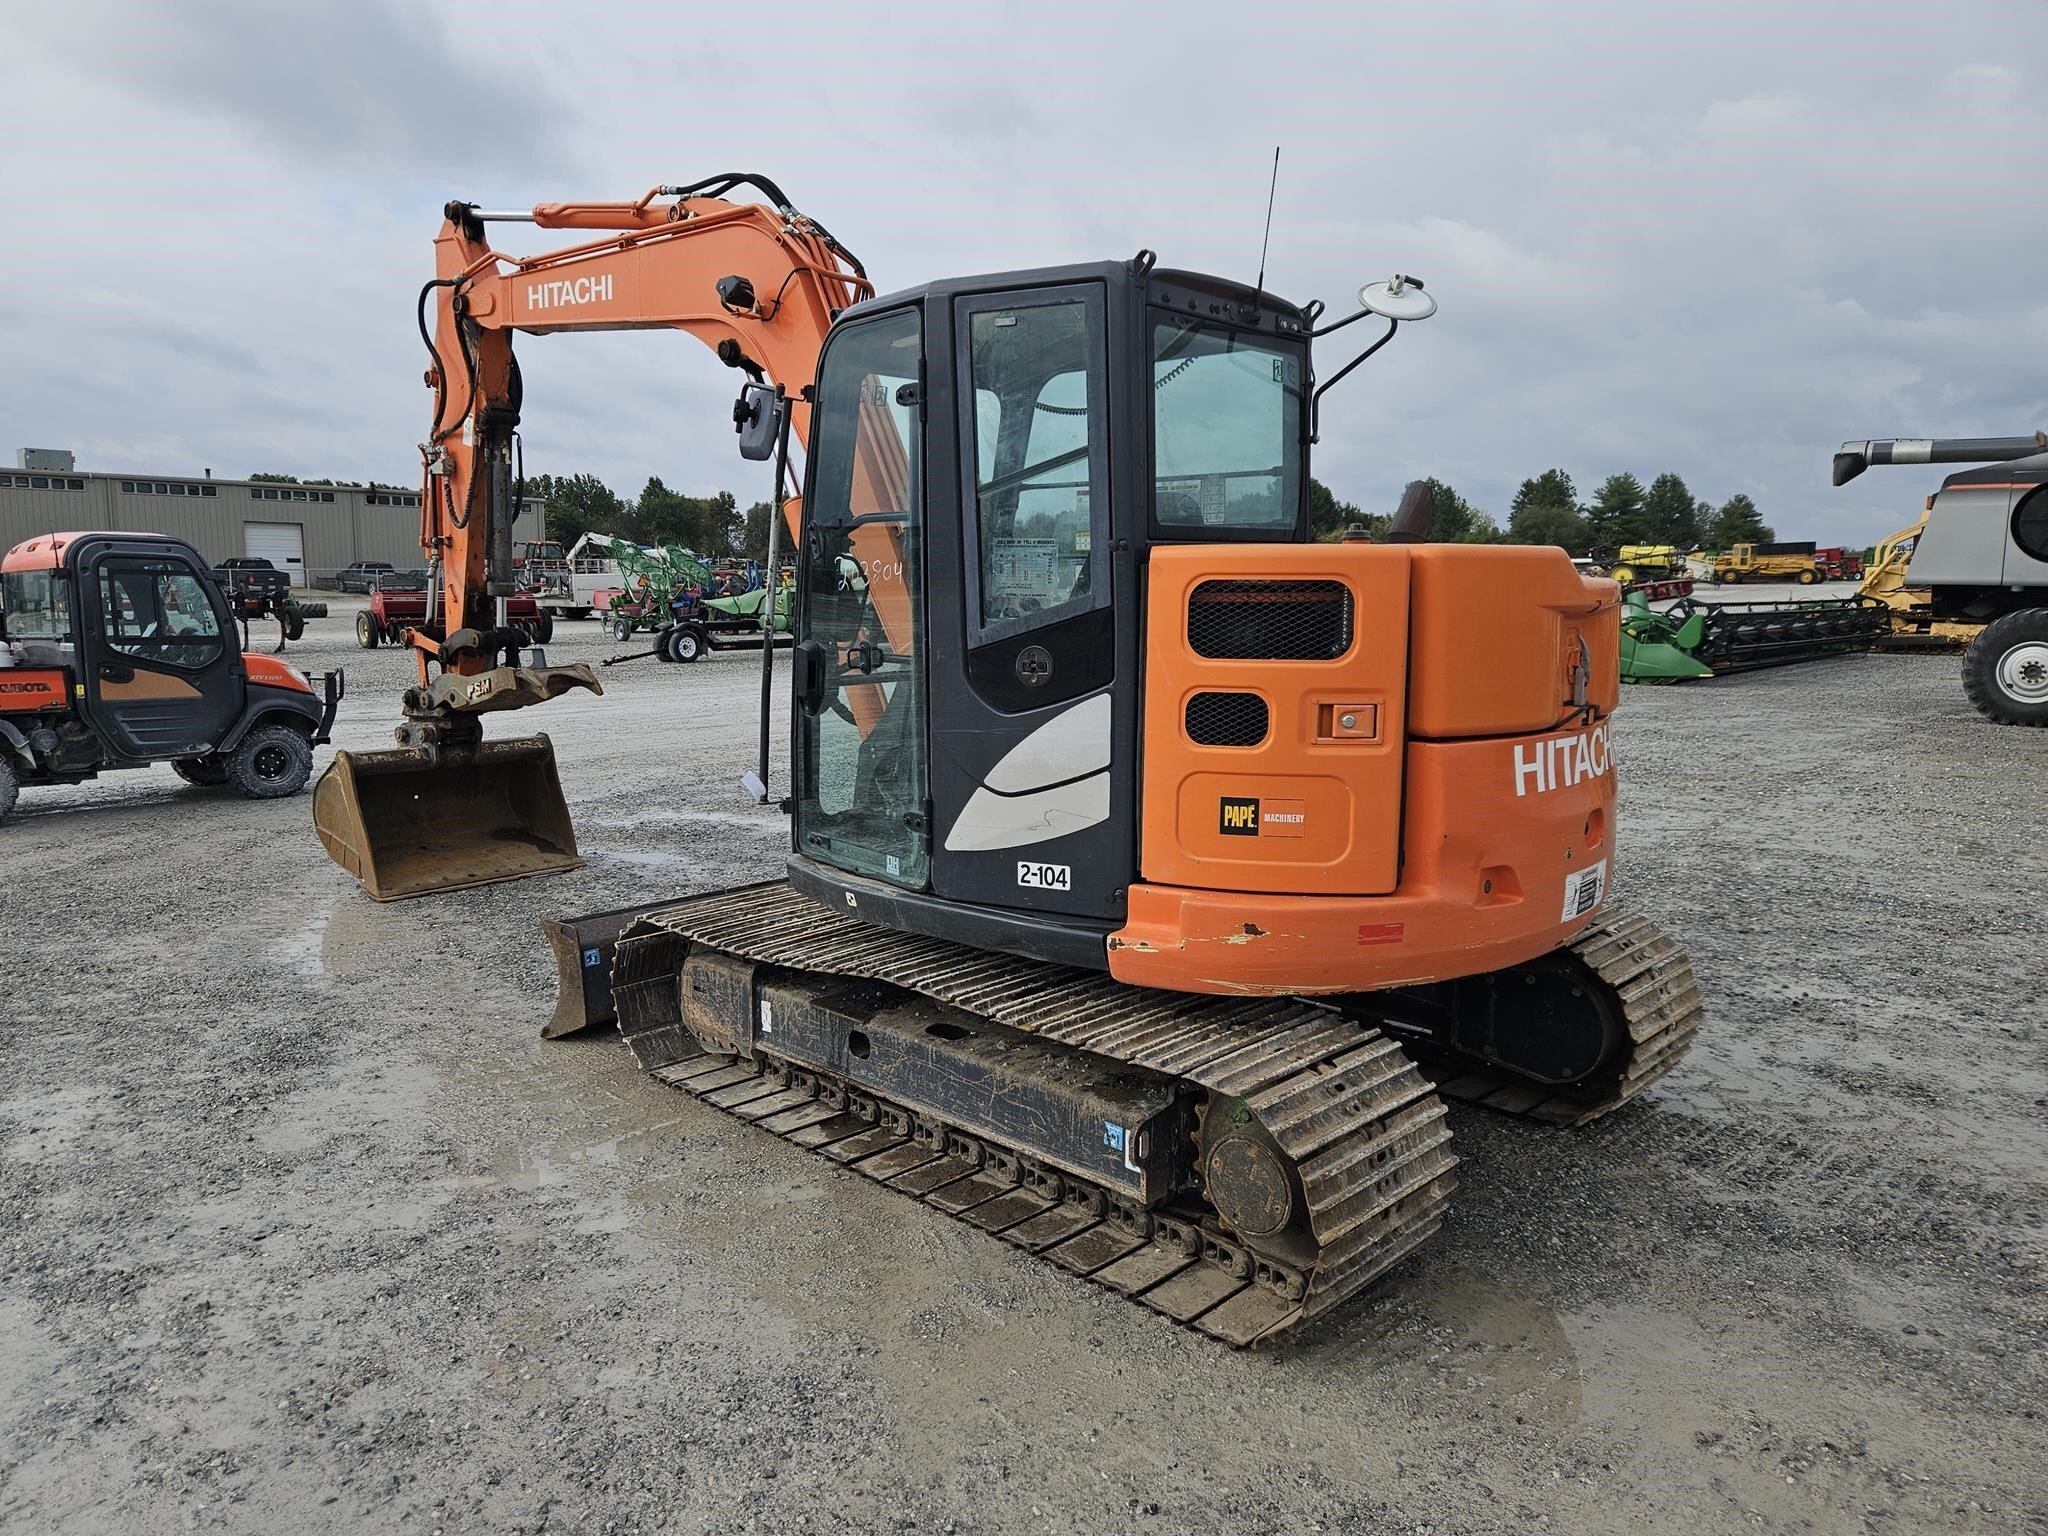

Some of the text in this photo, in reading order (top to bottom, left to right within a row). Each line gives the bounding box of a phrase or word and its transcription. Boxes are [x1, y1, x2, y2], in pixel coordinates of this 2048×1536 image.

[528, 273, 612, 310] HITACHI
[467, 678, 491, 699] PSM
[1263, 813, 1305, 823] MACHINERY
[1020, 864, 1068, 888] 2-104
